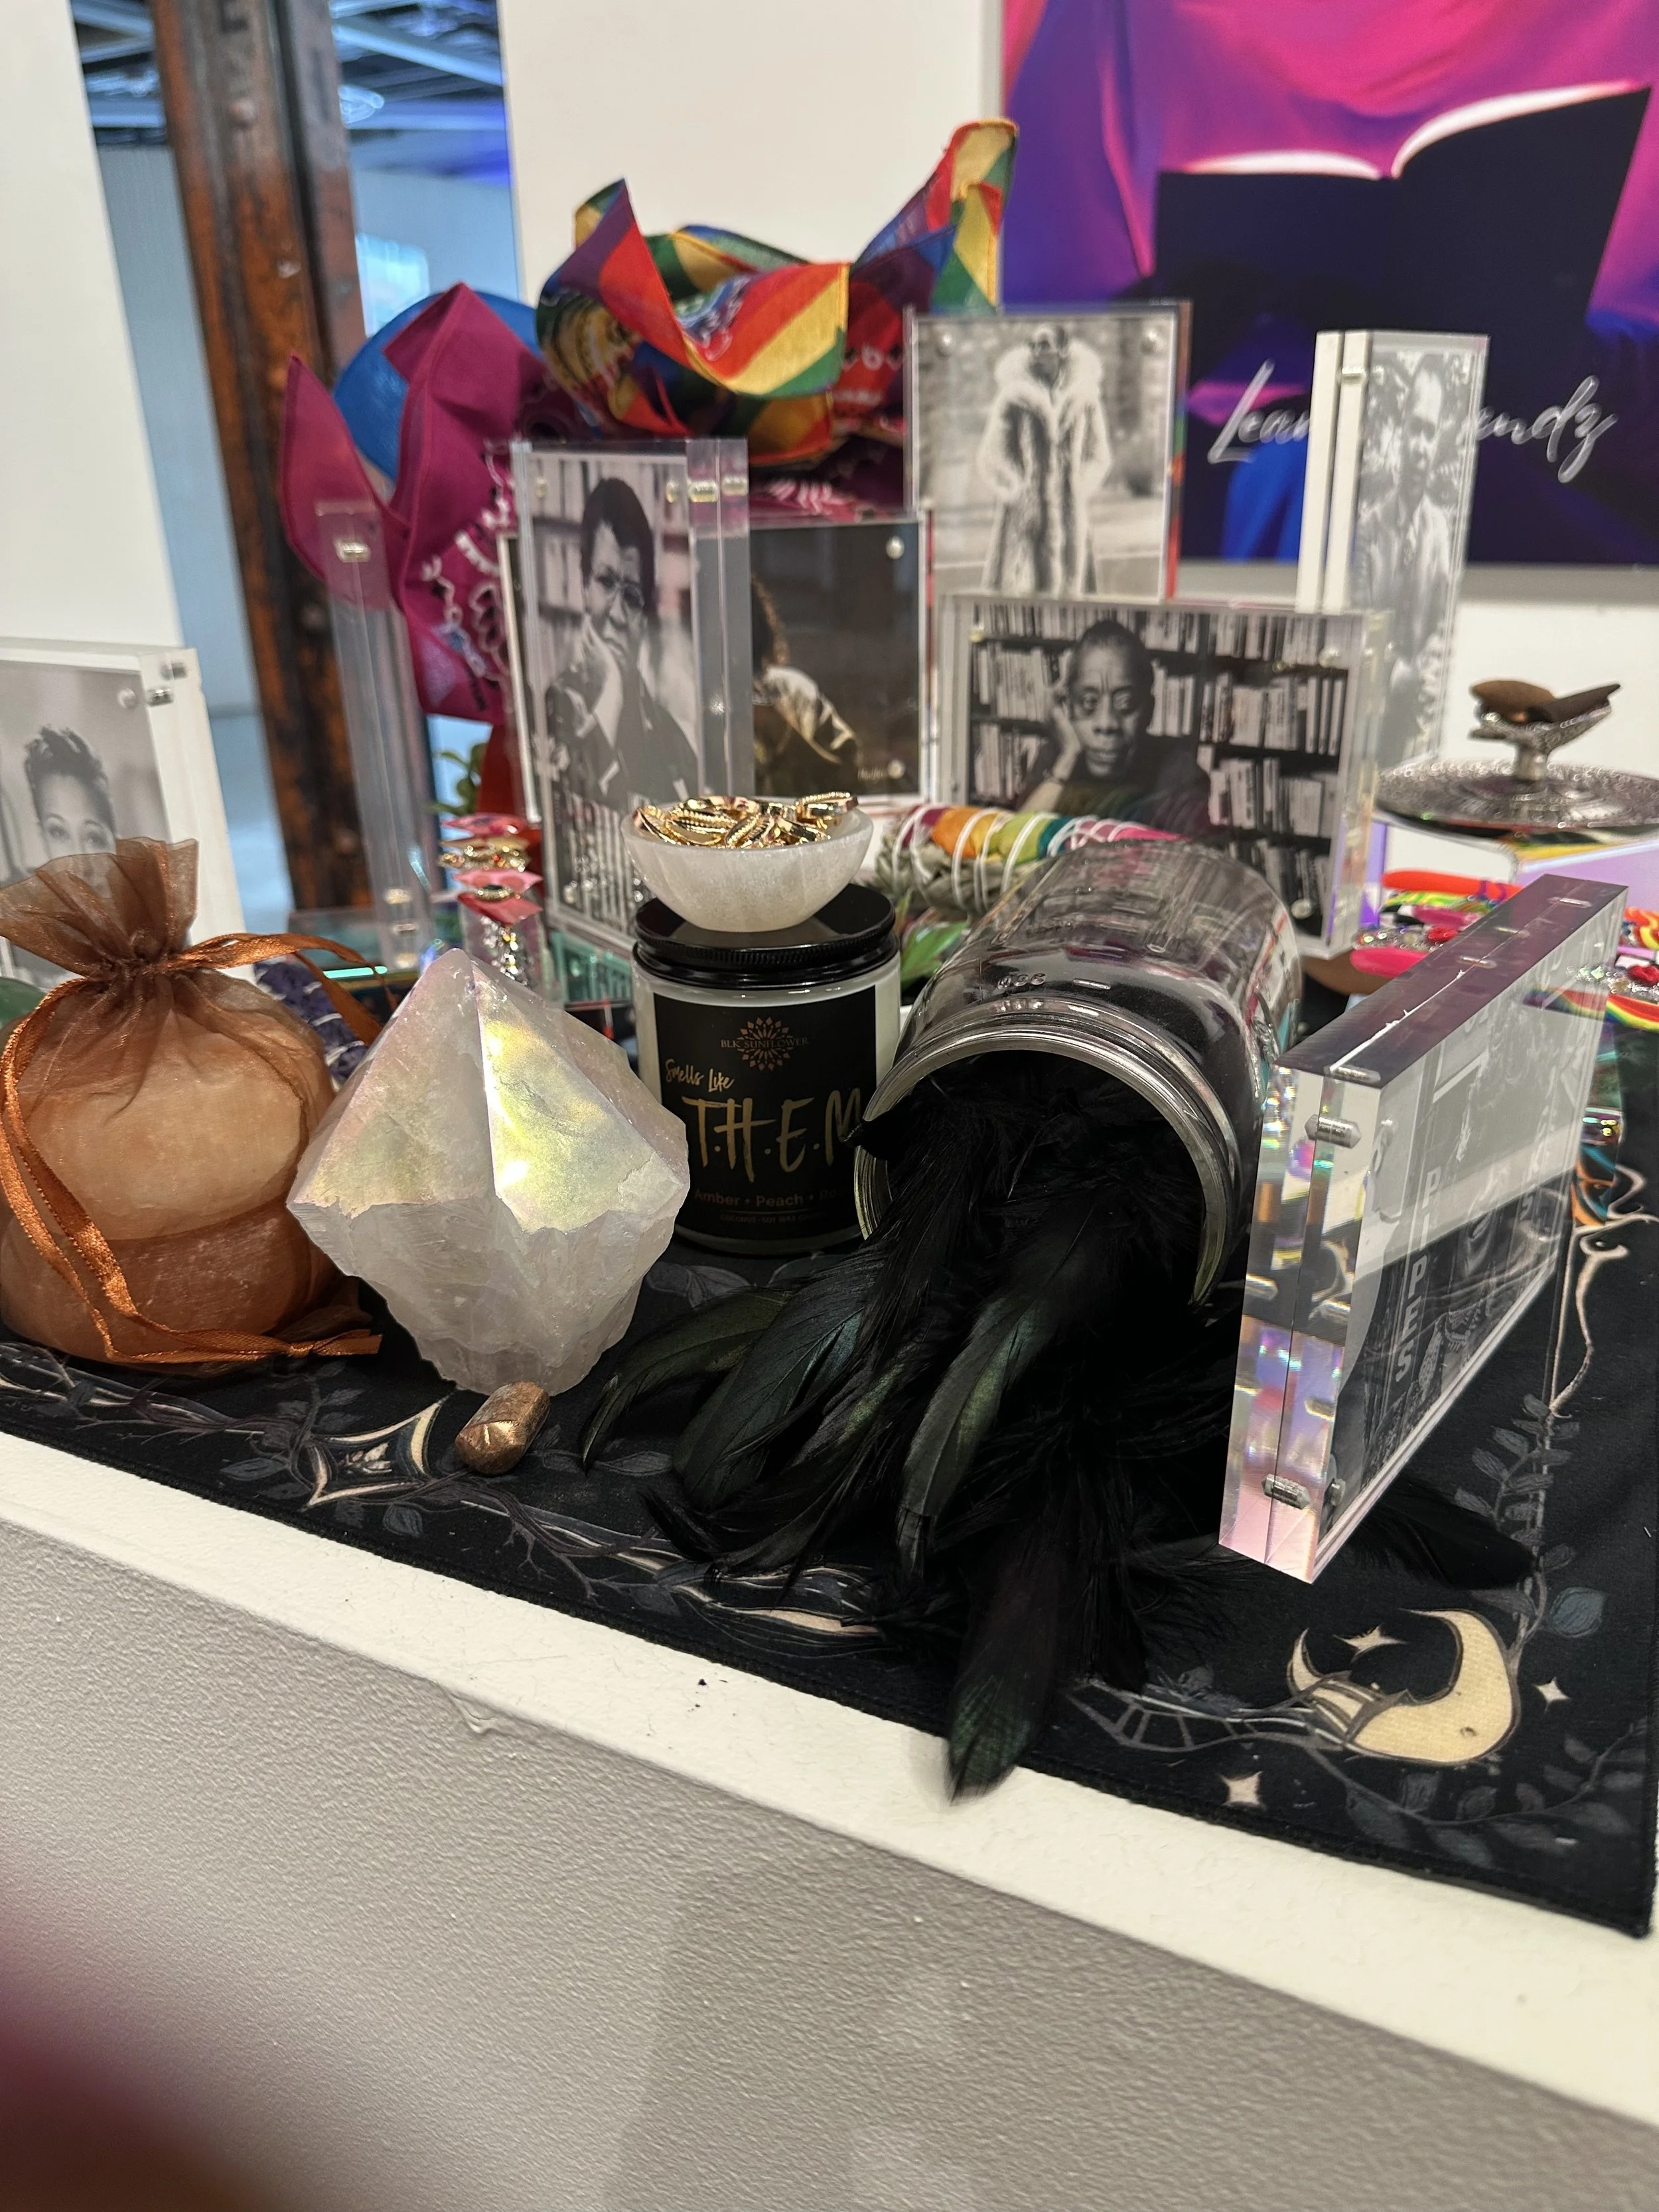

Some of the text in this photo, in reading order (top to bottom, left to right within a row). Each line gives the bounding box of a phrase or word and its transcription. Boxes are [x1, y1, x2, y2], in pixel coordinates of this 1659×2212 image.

[1475, 375, 1619, 484] endy
[721, 1036, 810, 1049] BLK SUNFLOWER
[665, 1058, 735, 1092] Smells Like
[693, 1187, 741, 1207] Amber
[755, 1193, 804, 1208] Peach
[1395, 1165, 1442, 1383] PIPES
